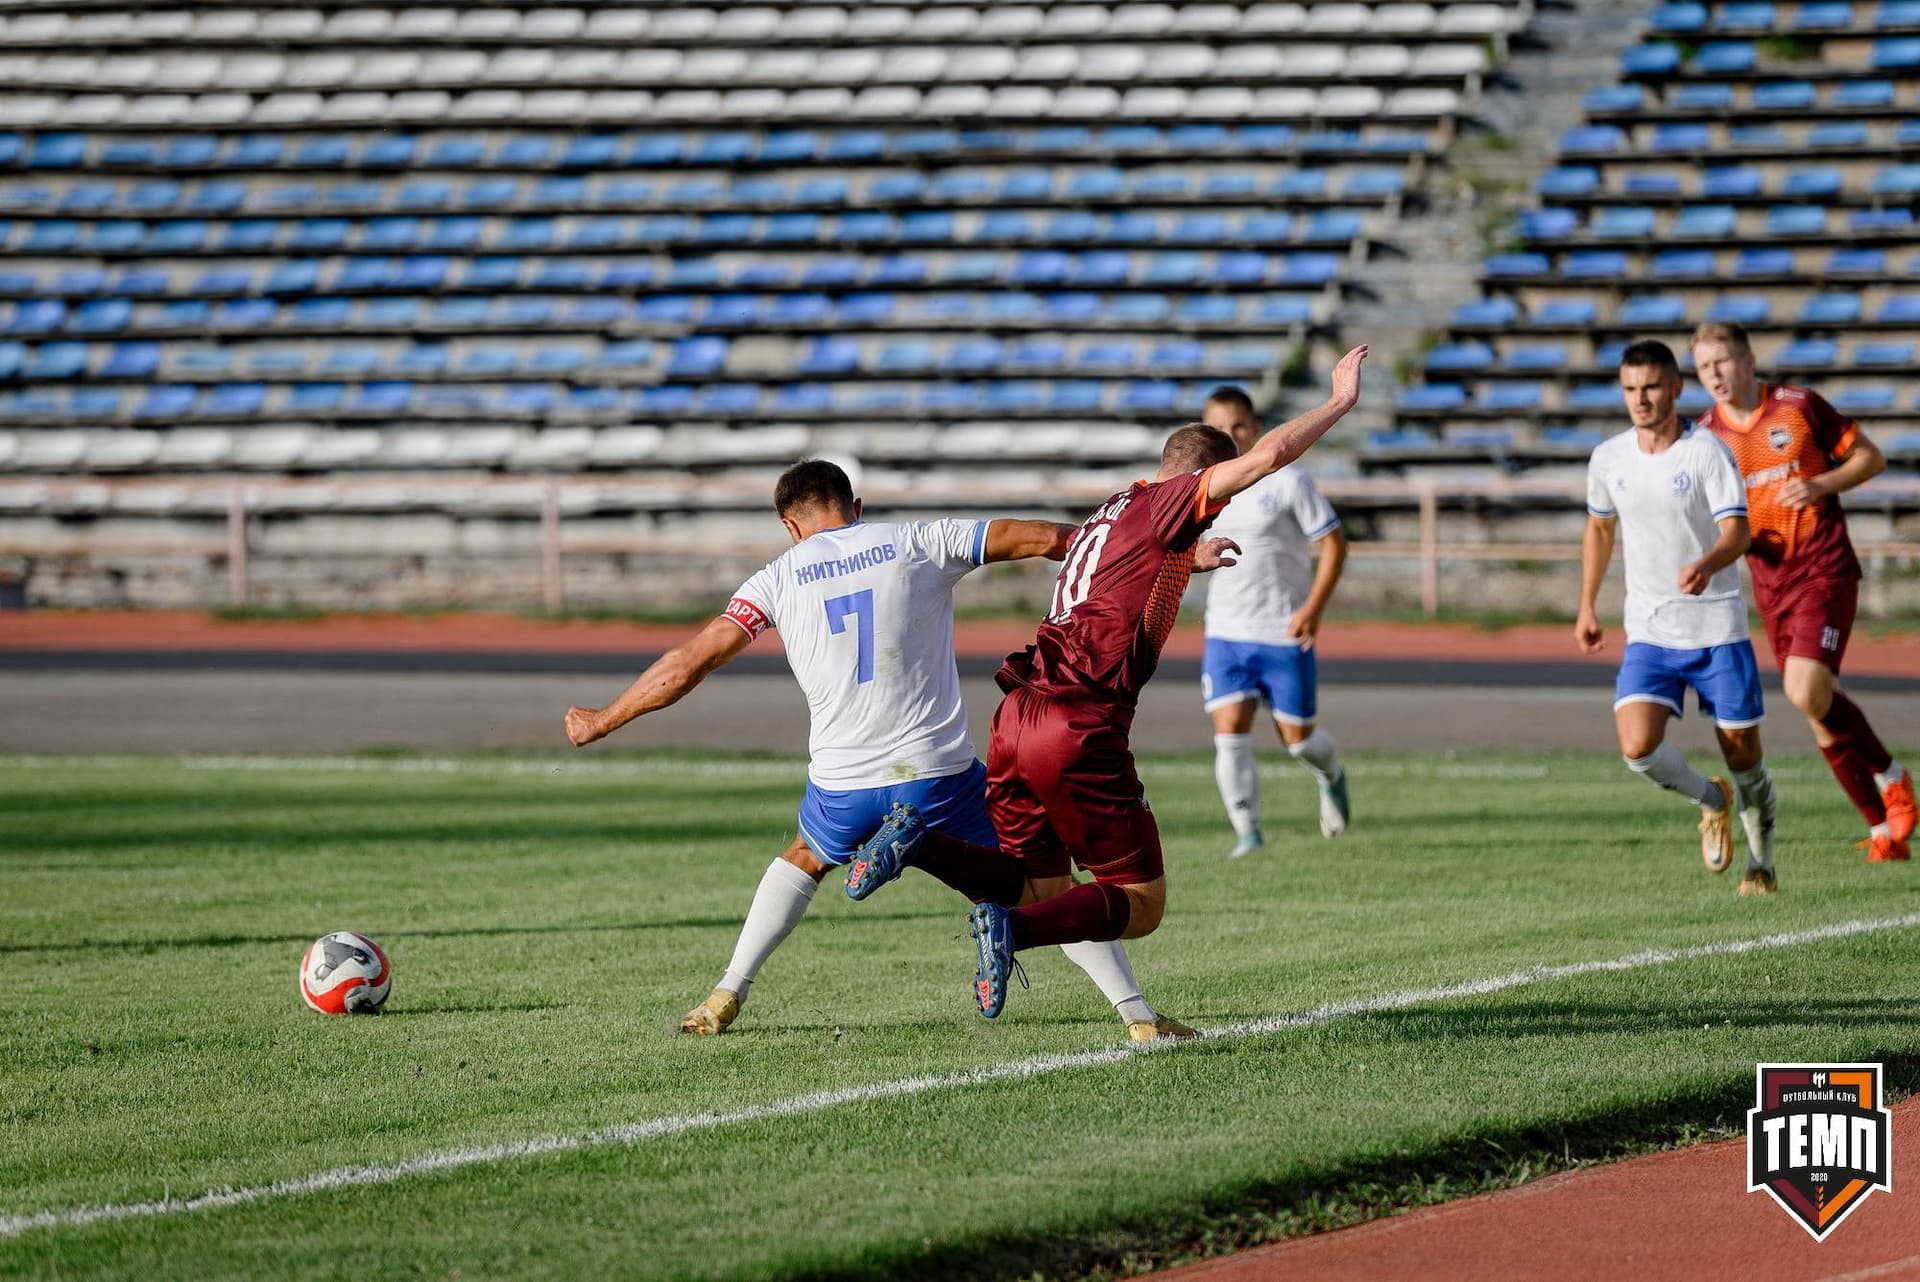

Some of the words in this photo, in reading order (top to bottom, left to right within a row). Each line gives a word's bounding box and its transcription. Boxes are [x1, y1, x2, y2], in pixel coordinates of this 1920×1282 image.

[795, 543, 897, 586] ЖИТНИКОВ
[1049, 522, 1112, 620] 10
[824, 588, 875, 685] 7
